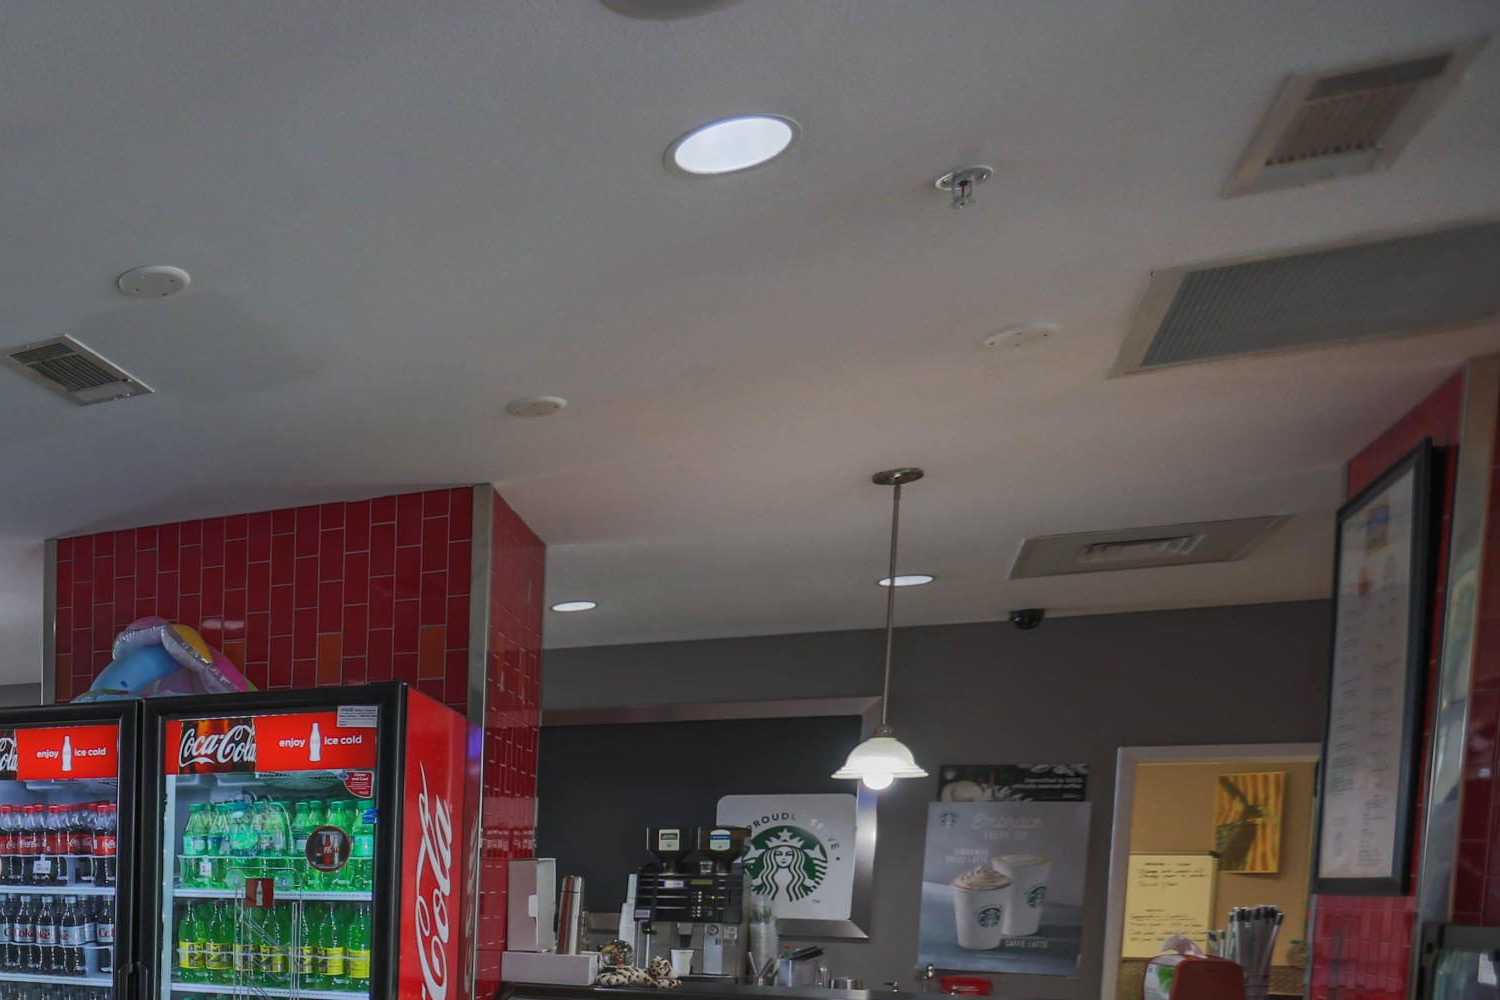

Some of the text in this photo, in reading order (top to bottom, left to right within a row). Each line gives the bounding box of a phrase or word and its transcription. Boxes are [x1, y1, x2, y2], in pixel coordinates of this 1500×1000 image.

[179, 725, 256, 768] Coca-Cola
[278, 735, 362, 748] enjoy ice cold
[36, 748, 107, 759] enjoy ice cold
